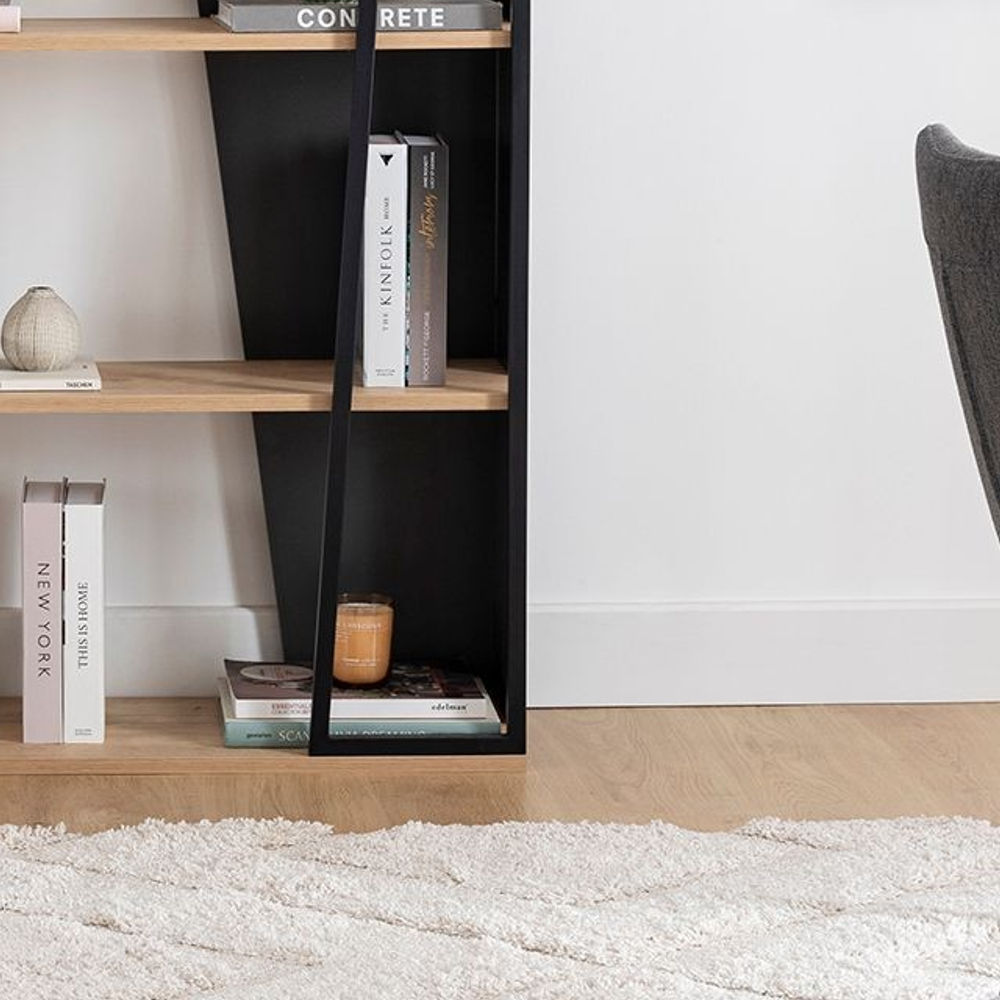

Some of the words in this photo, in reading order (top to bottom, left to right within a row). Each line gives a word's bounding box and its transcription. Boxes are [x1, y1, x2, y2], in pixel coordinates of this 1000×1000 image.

[296, 8, 445, 28] CONRETE
[380, 224, 392, 306] KINFOLK
[37, 562, 51, 611] NEW
[77, 582, 88, 622] HOME
[37, 621, 51, 679] YORK
[77, 624, 88, 636] IS
[77, 638, 88, 669] THIS
